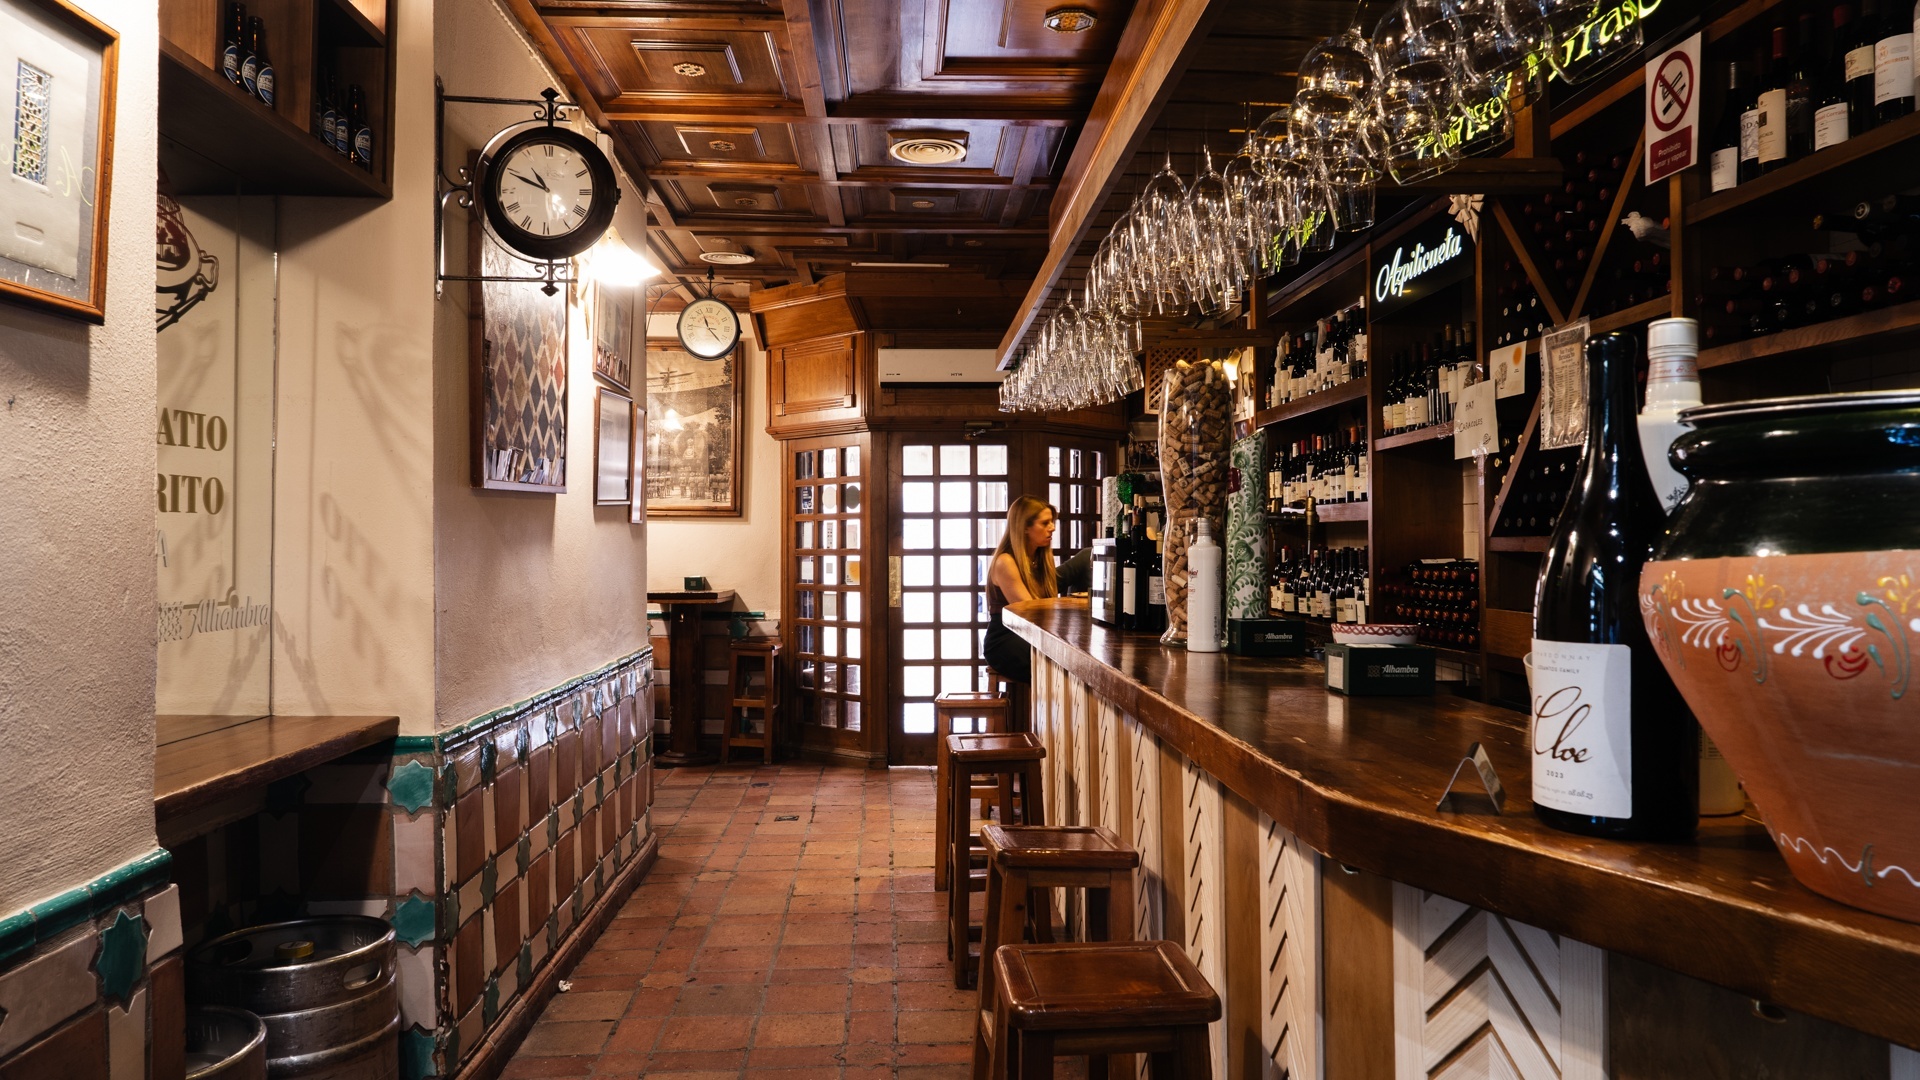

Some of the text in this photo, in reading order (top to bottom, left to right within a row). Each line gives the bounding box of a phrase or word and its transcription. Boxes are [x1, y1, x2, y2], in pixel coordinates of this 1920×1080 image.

[1658, 142, 1682, 157] Prohibido
[1375, 226, 1462, 302] Azpilicueta
[697, 314, 721, 326] KENINGTON
[157, 407, 228, 452] ATIO
[1459, 417, 1483, 433] CARACOLES
[187, 595, 270, 639] Alhambra
[1264, 632, 1293, 640] Alhambra
[1381, 664, 1420, 674] Alhambra
[1534, 685, 1594, 764] Cloe
[1546, 769, 1565, 779] 2023
